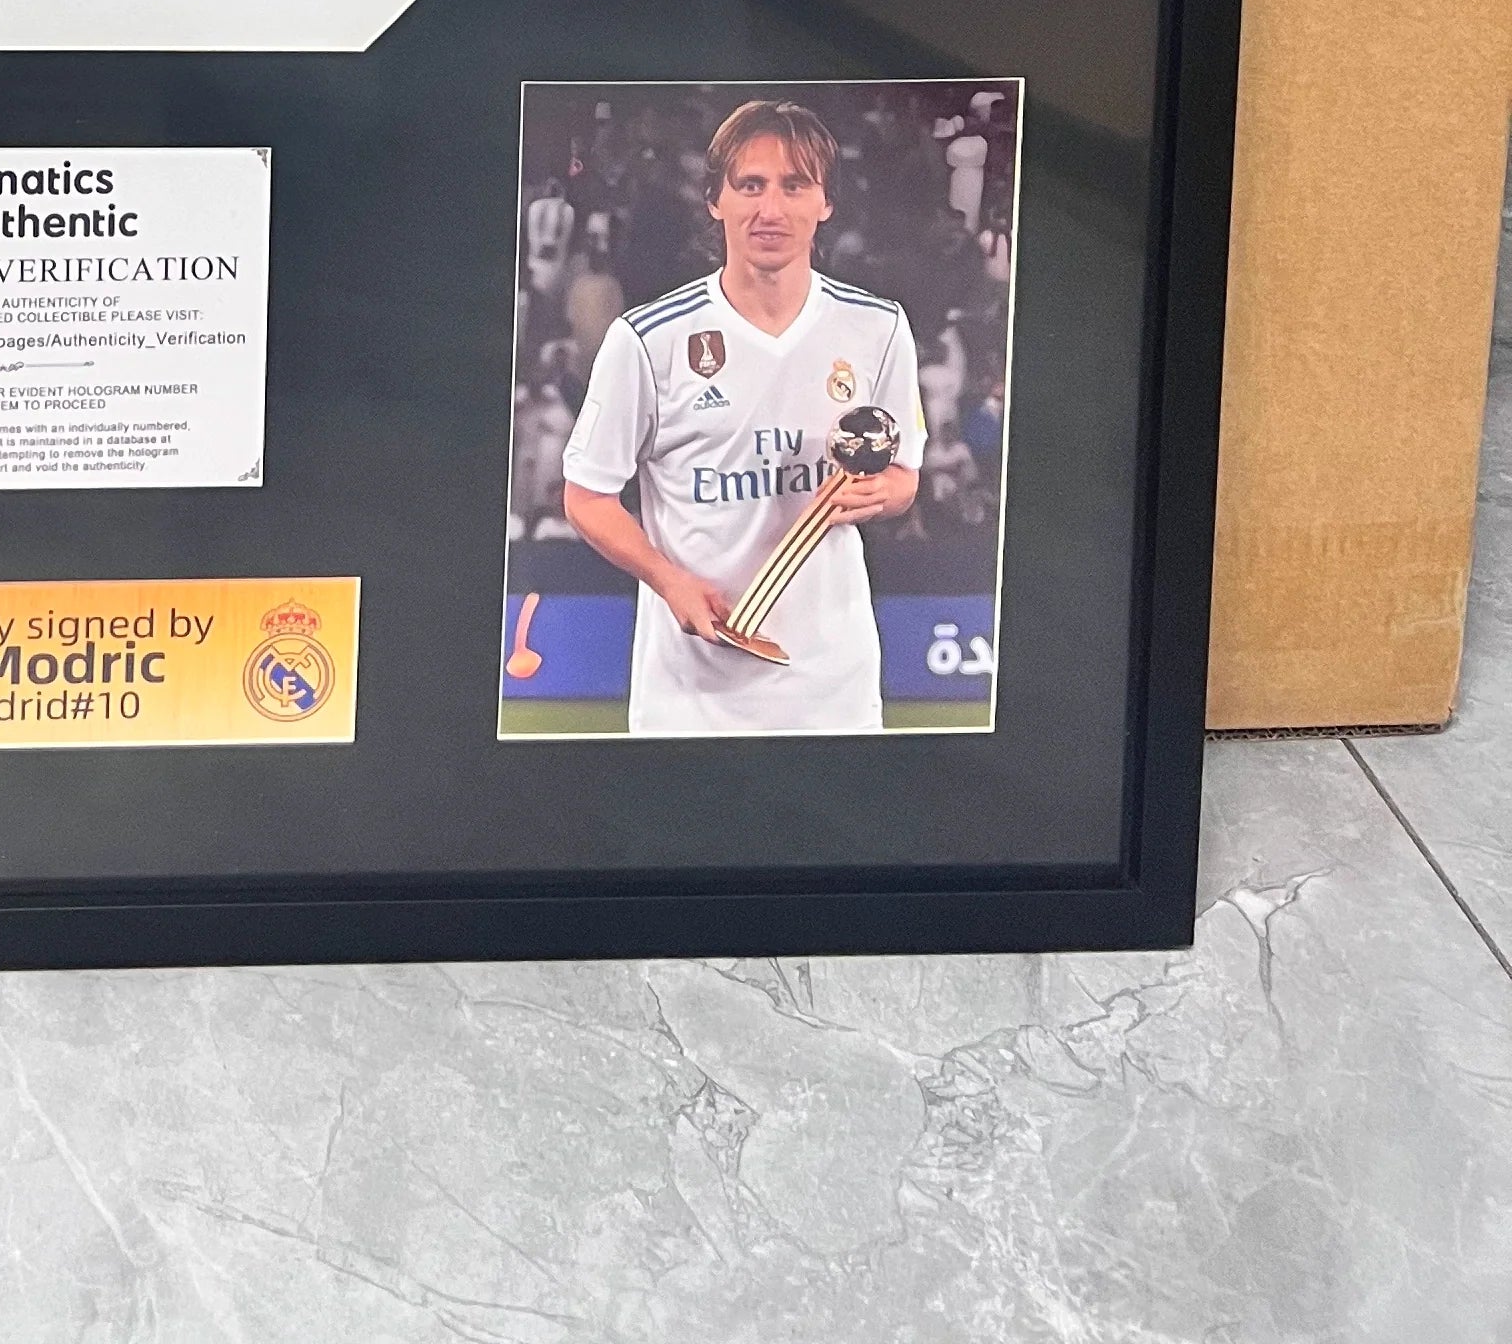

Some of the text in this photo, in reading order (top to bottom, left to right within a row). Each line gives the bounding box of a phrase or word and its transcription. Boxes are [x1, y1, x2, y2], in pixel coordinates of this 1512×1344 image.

[2, 297, 97, 308] AUTHENTICITY
[103, 296, 120, 307] OF
[17, 311, 107, 322] COLLECTIBLE
[111, 310, 162, 321] PLEASE
[10, 387, 63, 397] EVIDENT
[68, 385, 140, 396] HOLOGRAM
[145, 384, 197, 394] NUMBER
[23, 400, 40, 410] TO
[44, 399, 106, 409] PROCEED
[754, 427, 803, 456] Fly
[693, 455, 834, 503] Emirat
[28, 608, 155, 646] signed
[170, 608, 214, 645] by
